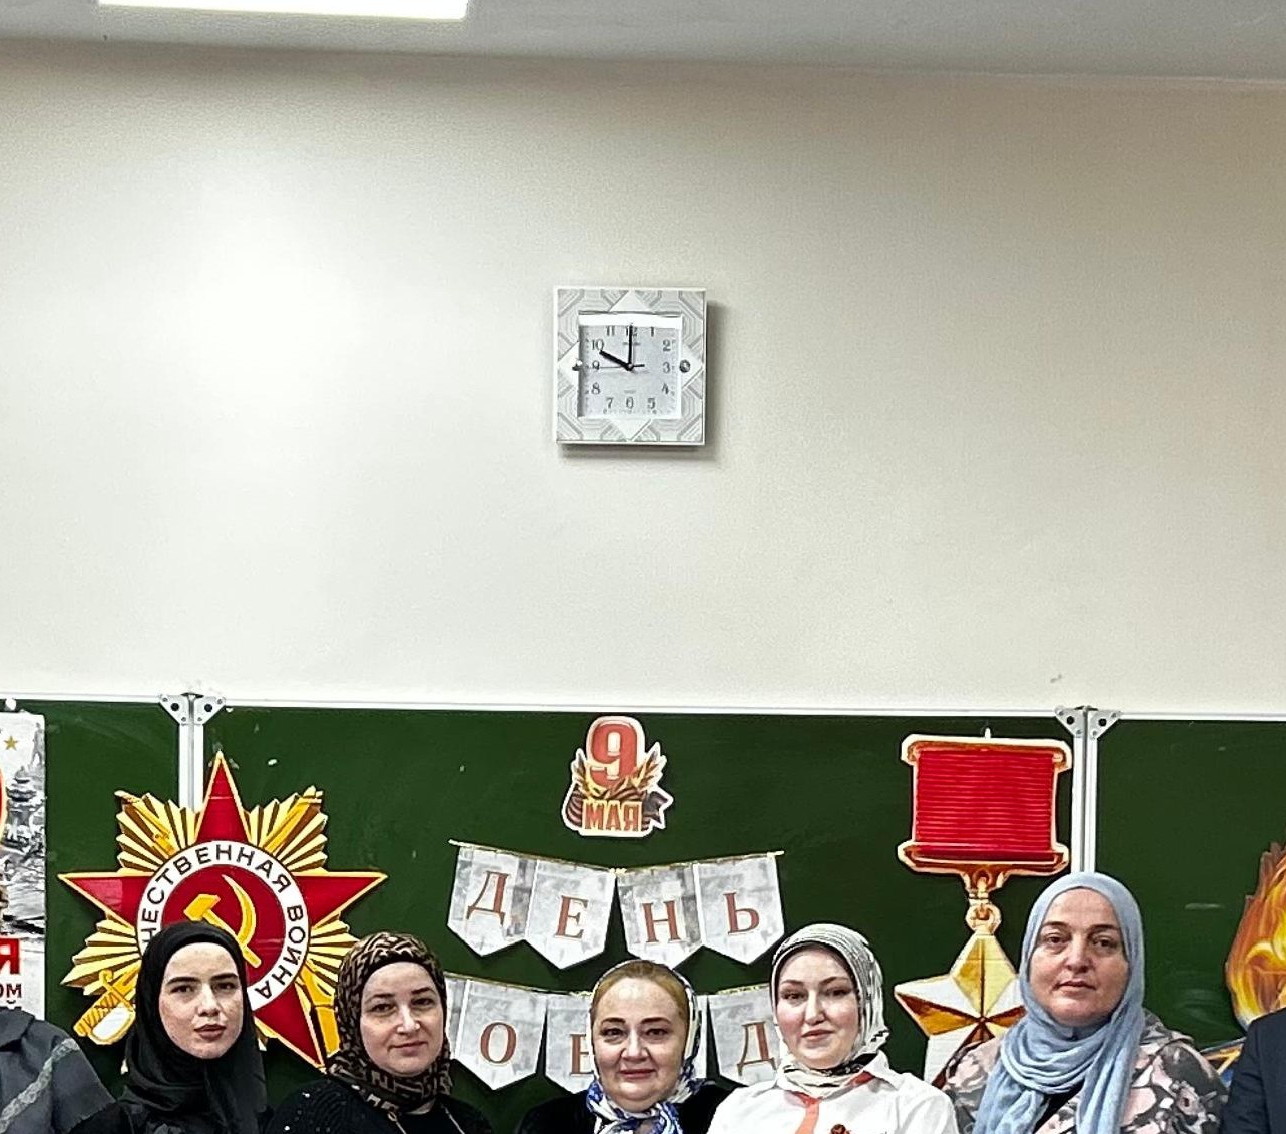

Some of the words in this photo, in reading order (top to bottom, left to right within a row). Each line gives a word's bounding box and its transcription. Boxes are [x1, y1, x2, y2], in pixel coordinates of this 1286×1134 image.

[648, 326, 655, 337] 1
[591, 338, 605, 351] 10
[662, 339, 671, 352] 2
[592, 360, 601, 371] 9
[662, 361, 671, 374] 3
[591, 382, 601, 395] 8
[661, 382, 670, 395] 4
[606, 397, 614, 409] 7
[647, 397, 656, 410] 5
[590, 722, 638, 790] 9
[583, 801, 641, 832] МАЯ
[465, 871, 761, 943] ДЕНЬ
[255, 905, 306, 999] ВОЙНА
